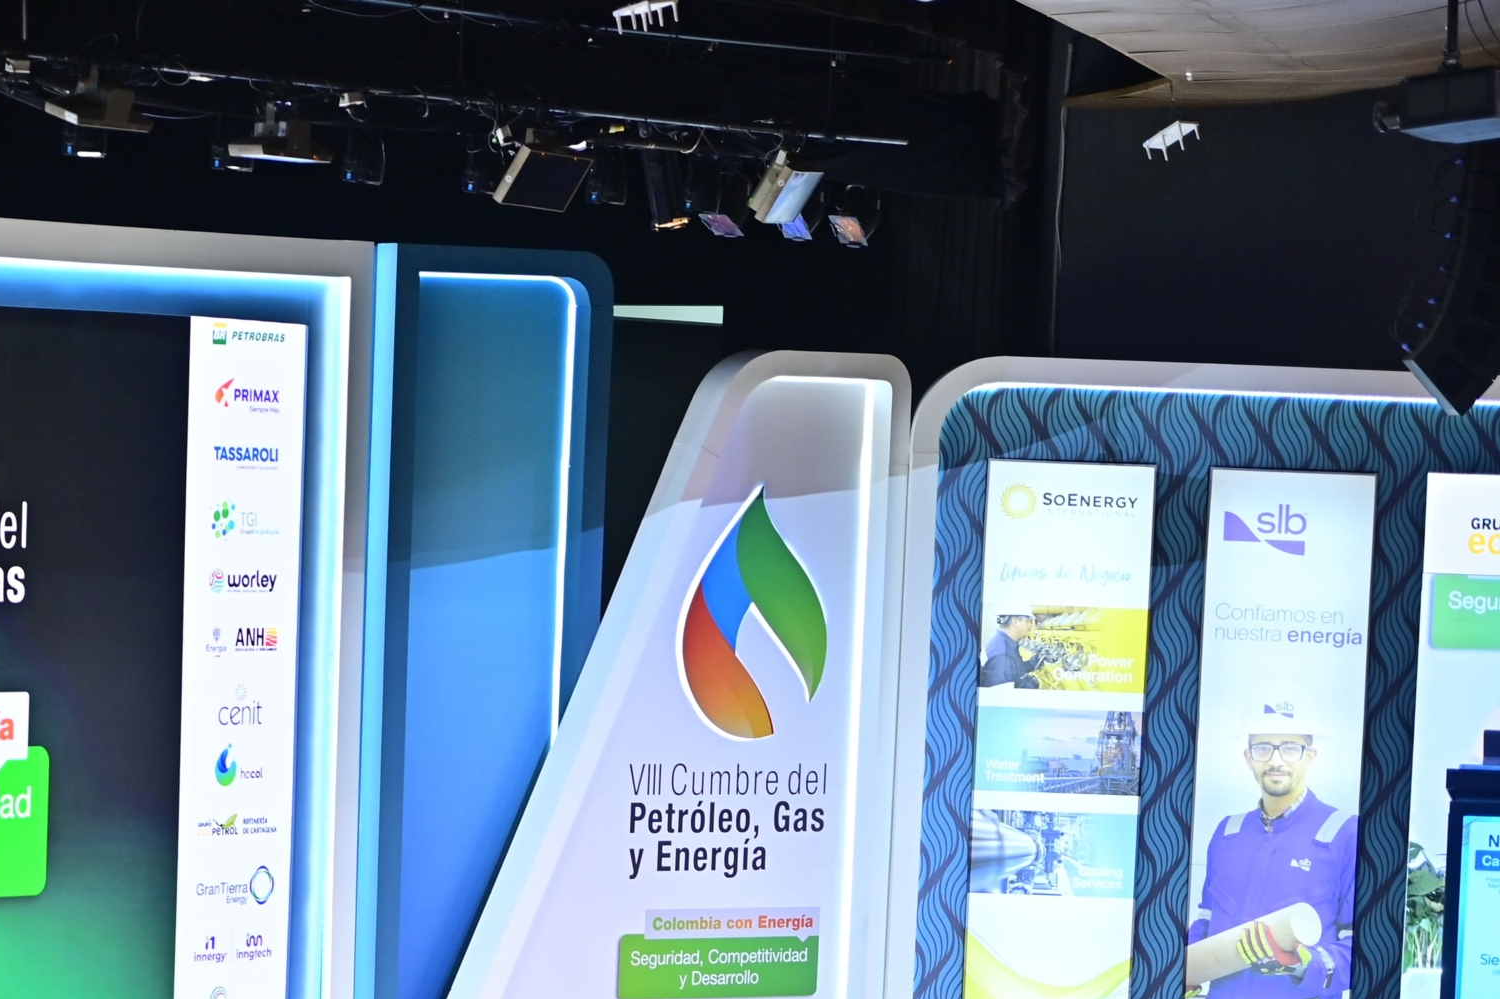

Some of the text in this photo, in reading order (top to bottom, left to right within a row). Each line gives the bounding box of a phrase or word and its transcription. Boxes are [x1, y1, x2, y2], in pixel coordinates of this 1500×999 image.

[232, 331, 286, 343] PETROBRAS
[233, 388, 279, 403] PRIMAX
[214, 446, 279, 463] TASSAROLI
[240, 512, 257, 526] TGI
[1257, 504, 1307, 535] slb
[227, 570, 277, 592] worley
[1448, 590, 1500, 614] Segu
[1215, 602, 1344, 624] Confiamos en
[235, 628, 264, 647] ANH
[1214, 626, 1363, 648] nuestra energía
[1088, 654, 1134, 668] Power
[1053, 667, 1134, 683] Generation
[218, 701, 262, 725] cenit
[985, 758, 1020, 769] Water
[240, 767, 263, 779] hocol
[629, 763, 827, 796] VIII Cumbre del
[985, 770, 1045, 783] Treatment
[629, 800, 825, 839] Petróleo, Gas
[629, 838, 767, 879] y Energía
[226, 896, 248, 905] Energy
[652, 914, 814, 931] Colombia con Energía
[194, 952, 225, 963] innergy
[630, 948, 808, 969] Seguridad, Competitividad
[679, 969, 759, 989] y Desarrollo
